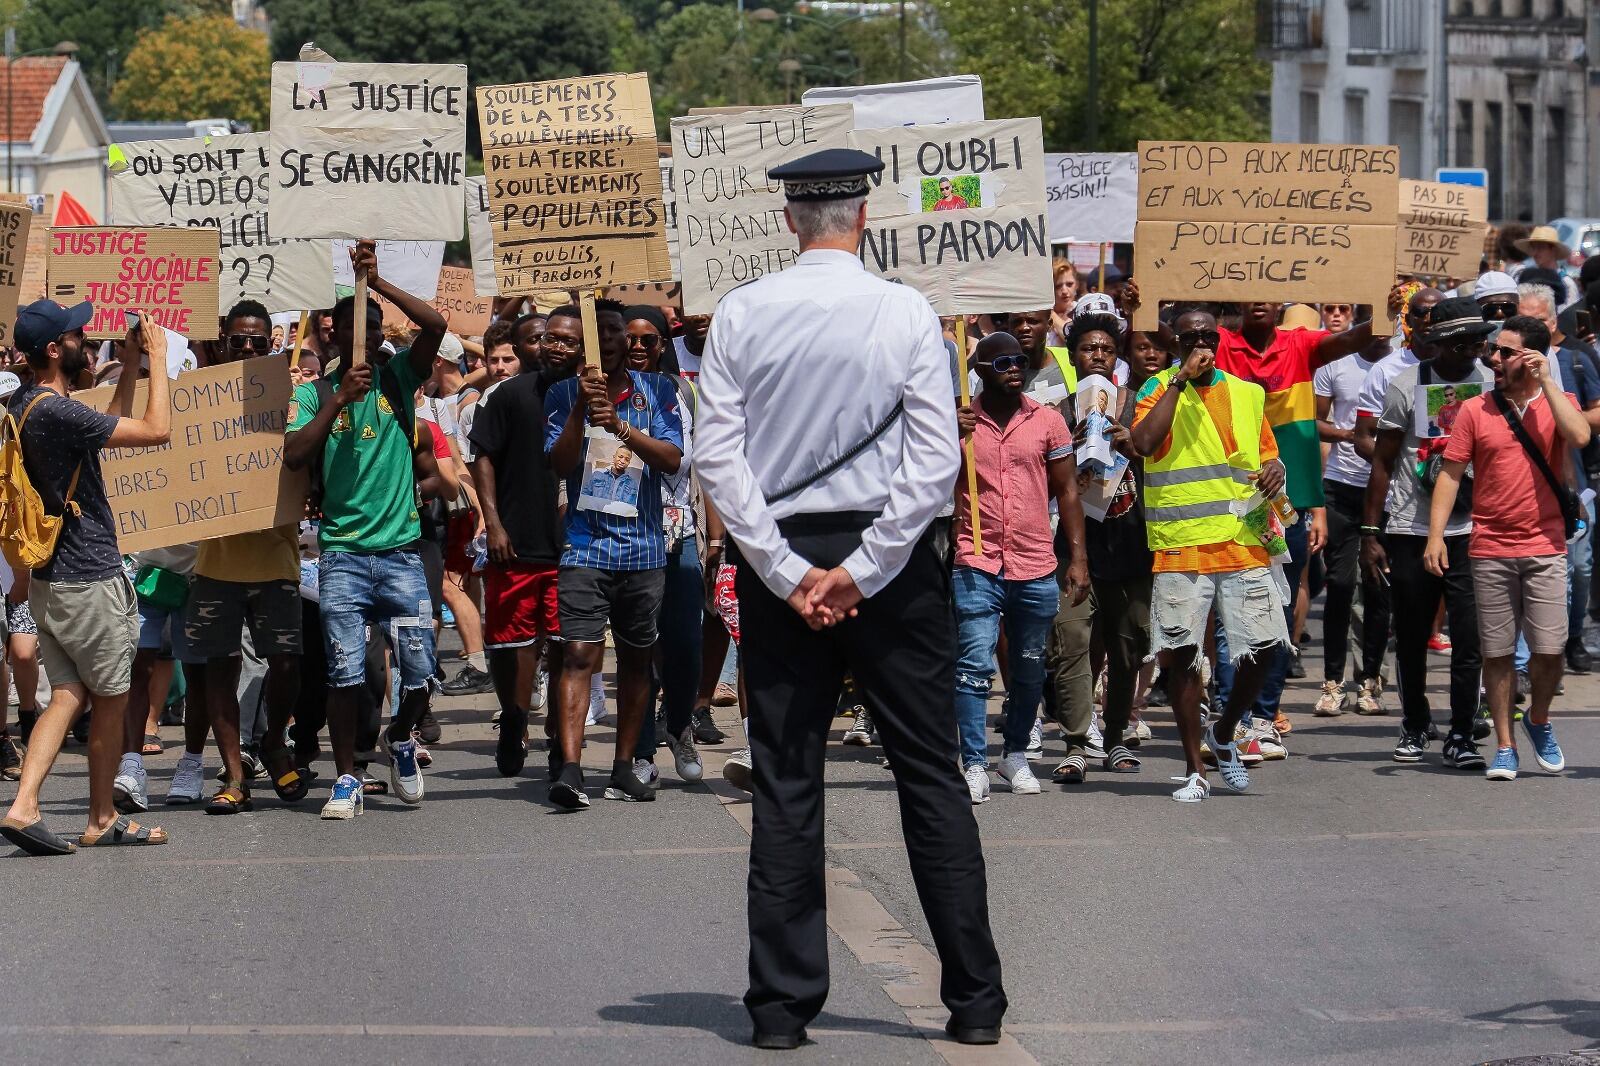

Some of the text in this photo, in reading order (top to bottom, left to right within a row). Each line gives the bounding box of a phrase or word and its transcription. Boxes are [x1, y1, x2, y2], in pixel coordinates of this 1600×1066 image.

[292, 82, 328, 110] LA
[487, 108, 514, 125] DE
[521, 110, 552, 124] LA
[683, 108, 817, 158] UN TUÉ
[133, 149, 162, 176] OÙ
[173, 148, 245, 175] SONT
[279, 138, 462, 188] SE GANGRÈNE
[492, 154, 511, 171] DE
[519, 149, 541, 168] LA
[917, 136, 1022, 176] OUBLI
[1142, 146, 1227, 175] STOP
[1244, 149, 1291, 173] AUX
[684, 165, 755, 203] POUR
[1047, 176, 1108, 202] SSASIN!!
[1145, 185, 1174, 207] ET
[1182, 186, 1224, 207] AUX
[1413, 185, 1464, 206] PAS DE
[687, 209, 785, 247] DISANT
[1406, 209, 1469, 227] JUSTICE
[861, 228, 899, 273] NI
[917, 214, 1047, 265] PARDON
[1410, 231, 1459, 249] PAS DE
[1413, 254, 1449, 273] PAIX
[171, 375, 265, 412] OMMES
[186, 424, 203, 447] ET
[103, 446, 283, 498] LIBRES ET EGAUX
[118, 490, 242, 535] EN DROIT
